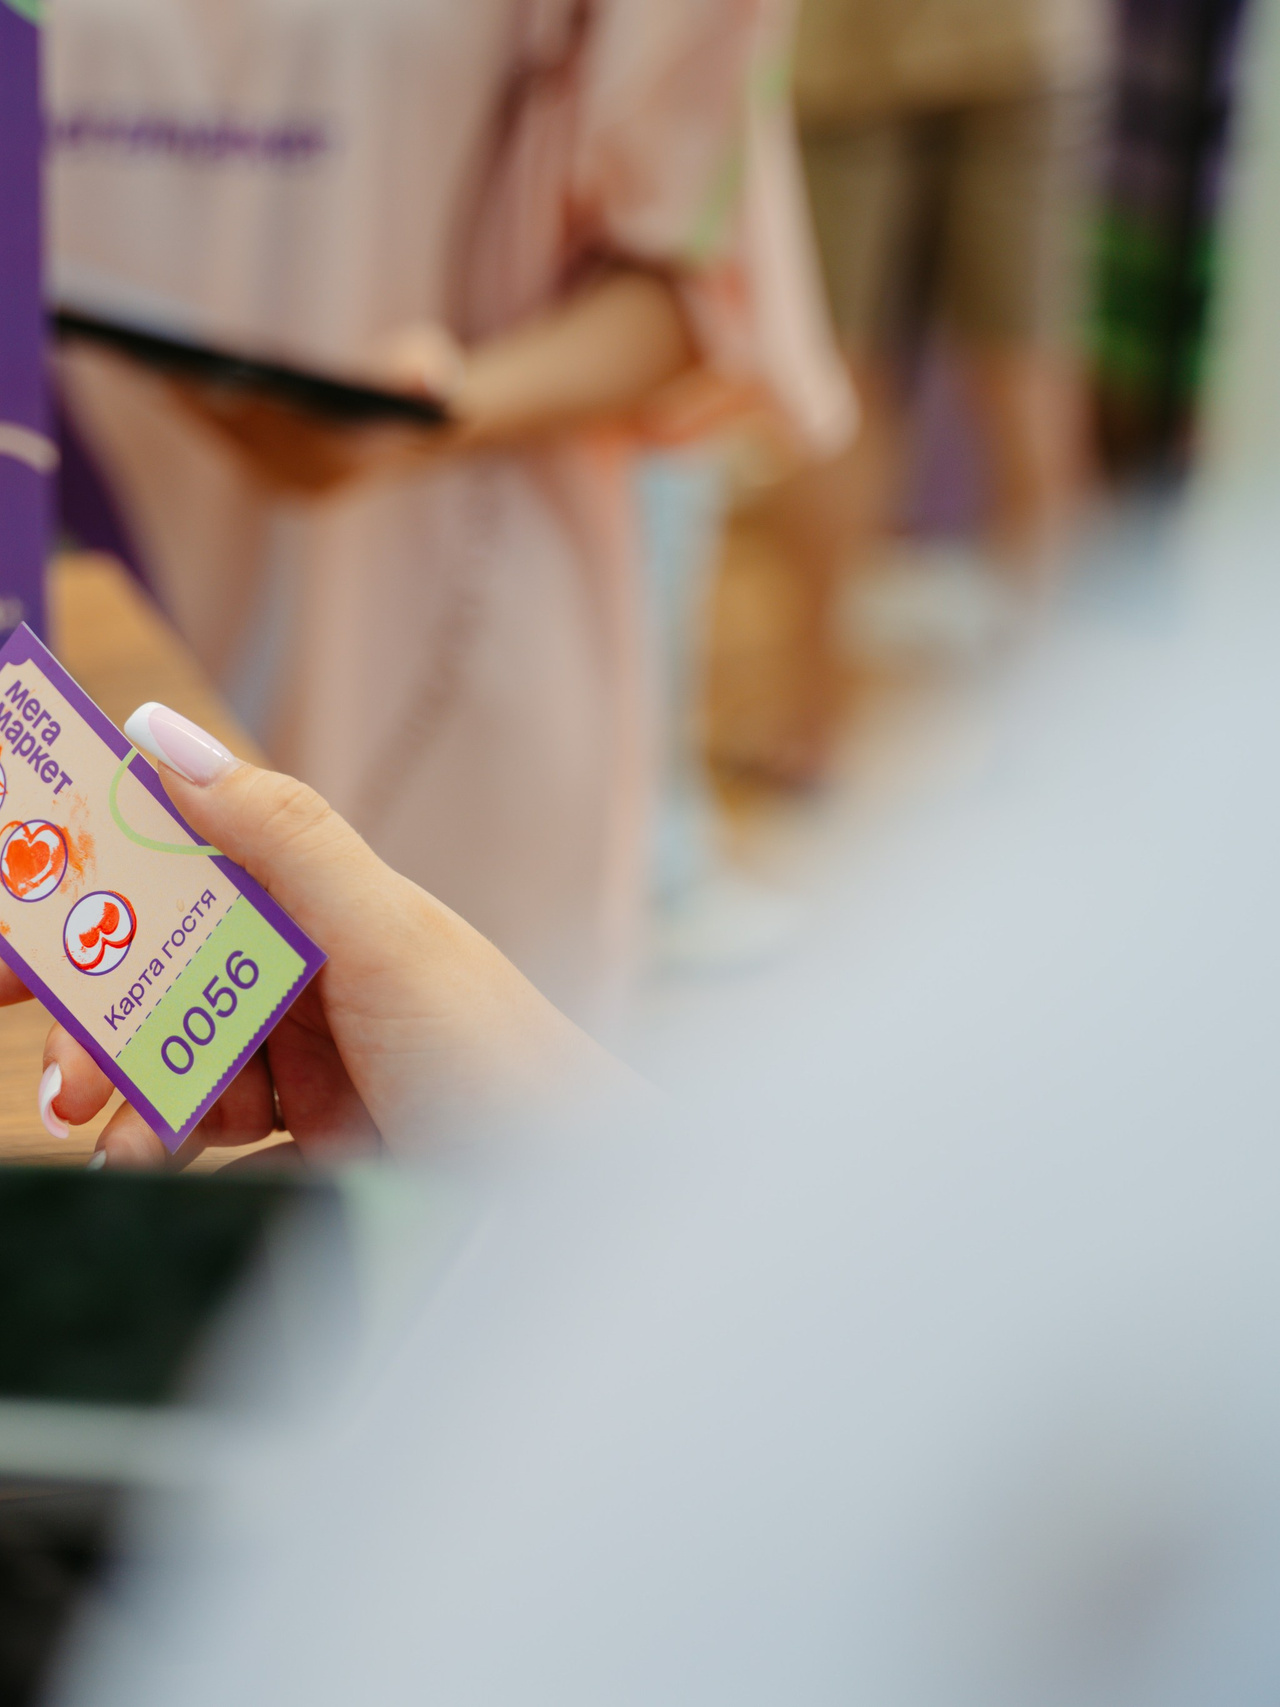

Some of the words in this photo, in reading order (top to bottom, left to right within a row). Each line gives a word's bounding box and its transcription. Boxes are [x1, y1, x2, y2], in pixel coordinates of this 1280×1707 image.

[4, 680, 61, 747] мега
[103, 958, 165, 1031] Карта
[161, 889, 217, 959] гостя
[160, 950, 260, 1076] 0056
